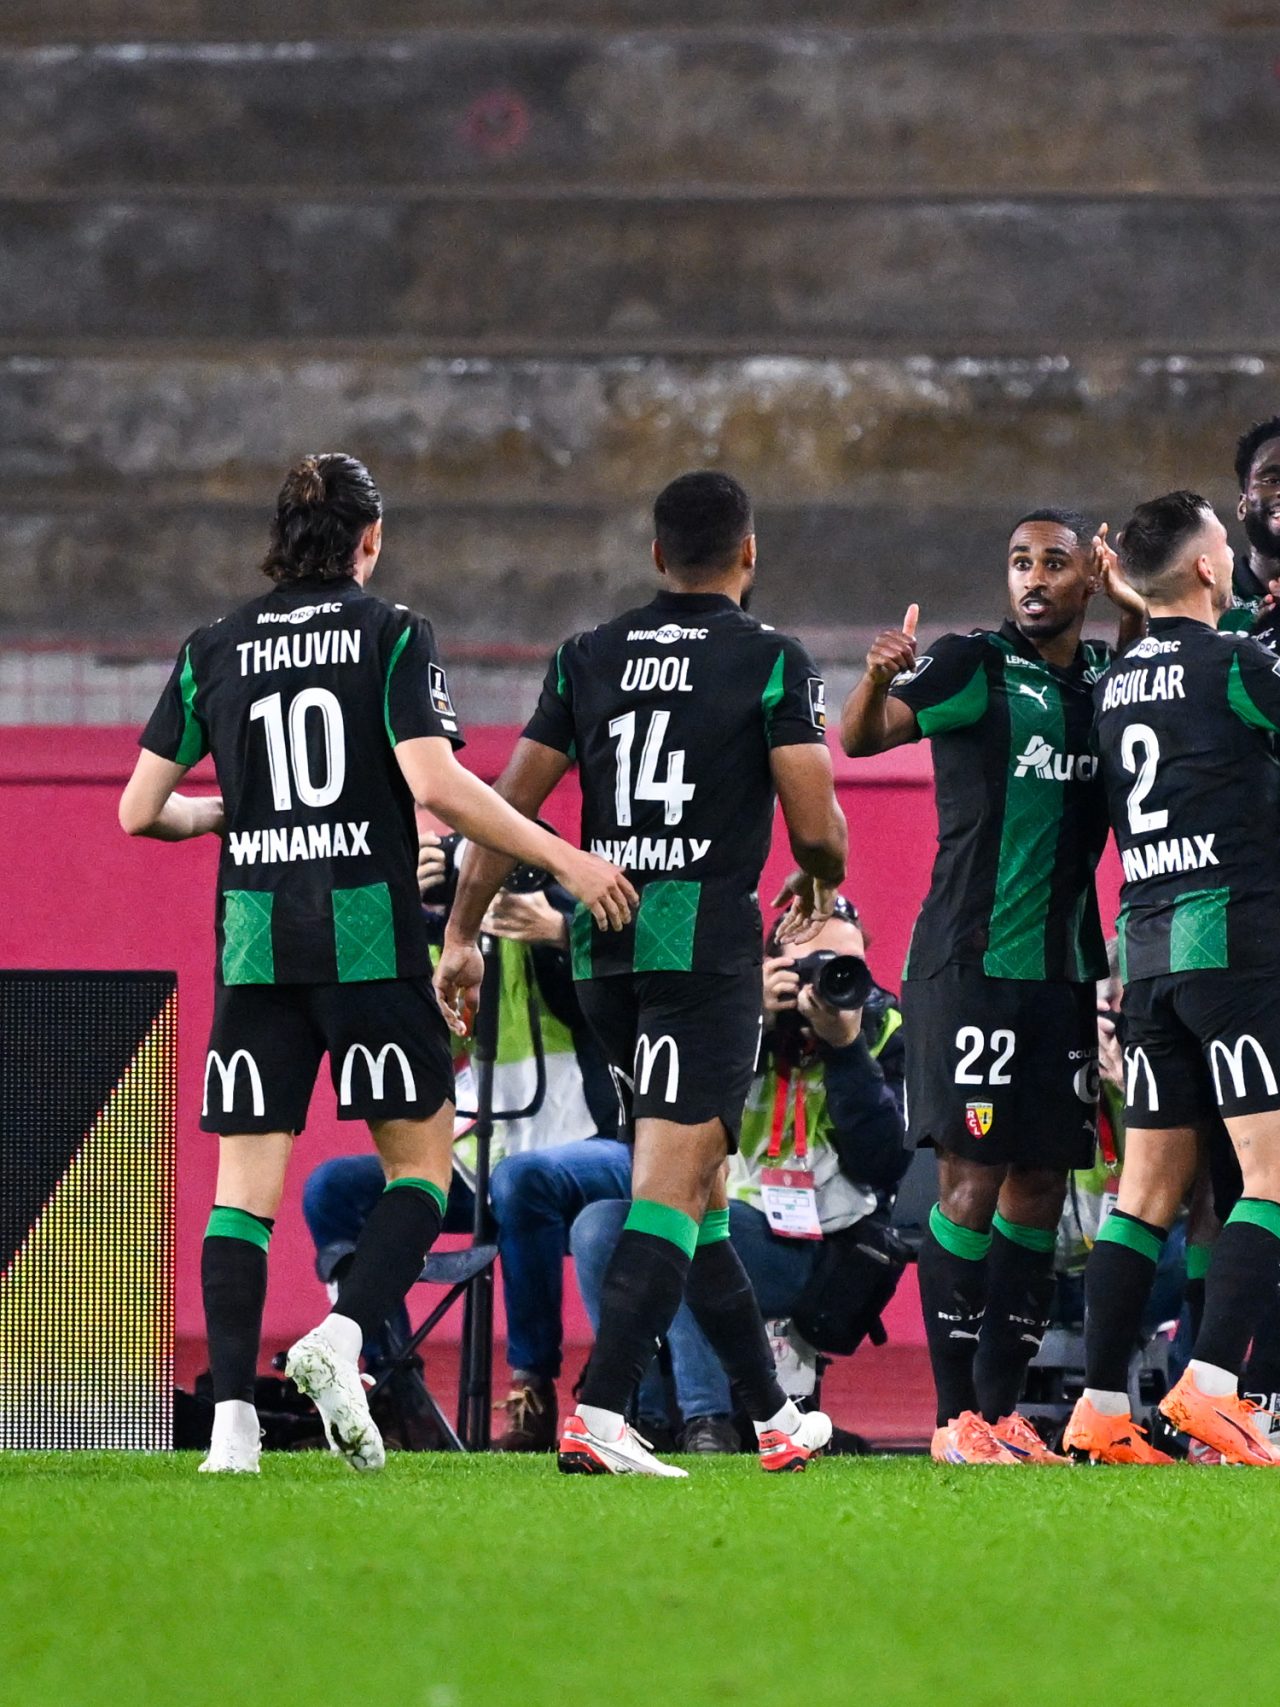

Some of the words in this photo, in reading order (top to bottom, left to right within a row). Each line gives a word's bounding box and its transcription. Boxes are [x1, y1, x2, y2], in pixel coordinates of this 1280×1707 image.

[236, 629, 361, 677] THAUVIN
[626, 623, 709, 645] MURPROTEC
[620, 656, 693, 692] UDOL
[1102, 664, 1186, 712] AGUILAR
[250, 687, 346, 812] 10
[608, 710, 696, 827] 14
[1121, 723, 1169, 835] 2
[229, 820, 372, 867] WINAMAX
[1121, 833, 1219, 883] INAMAX
[954, 1025, 1016, 1086] 22
